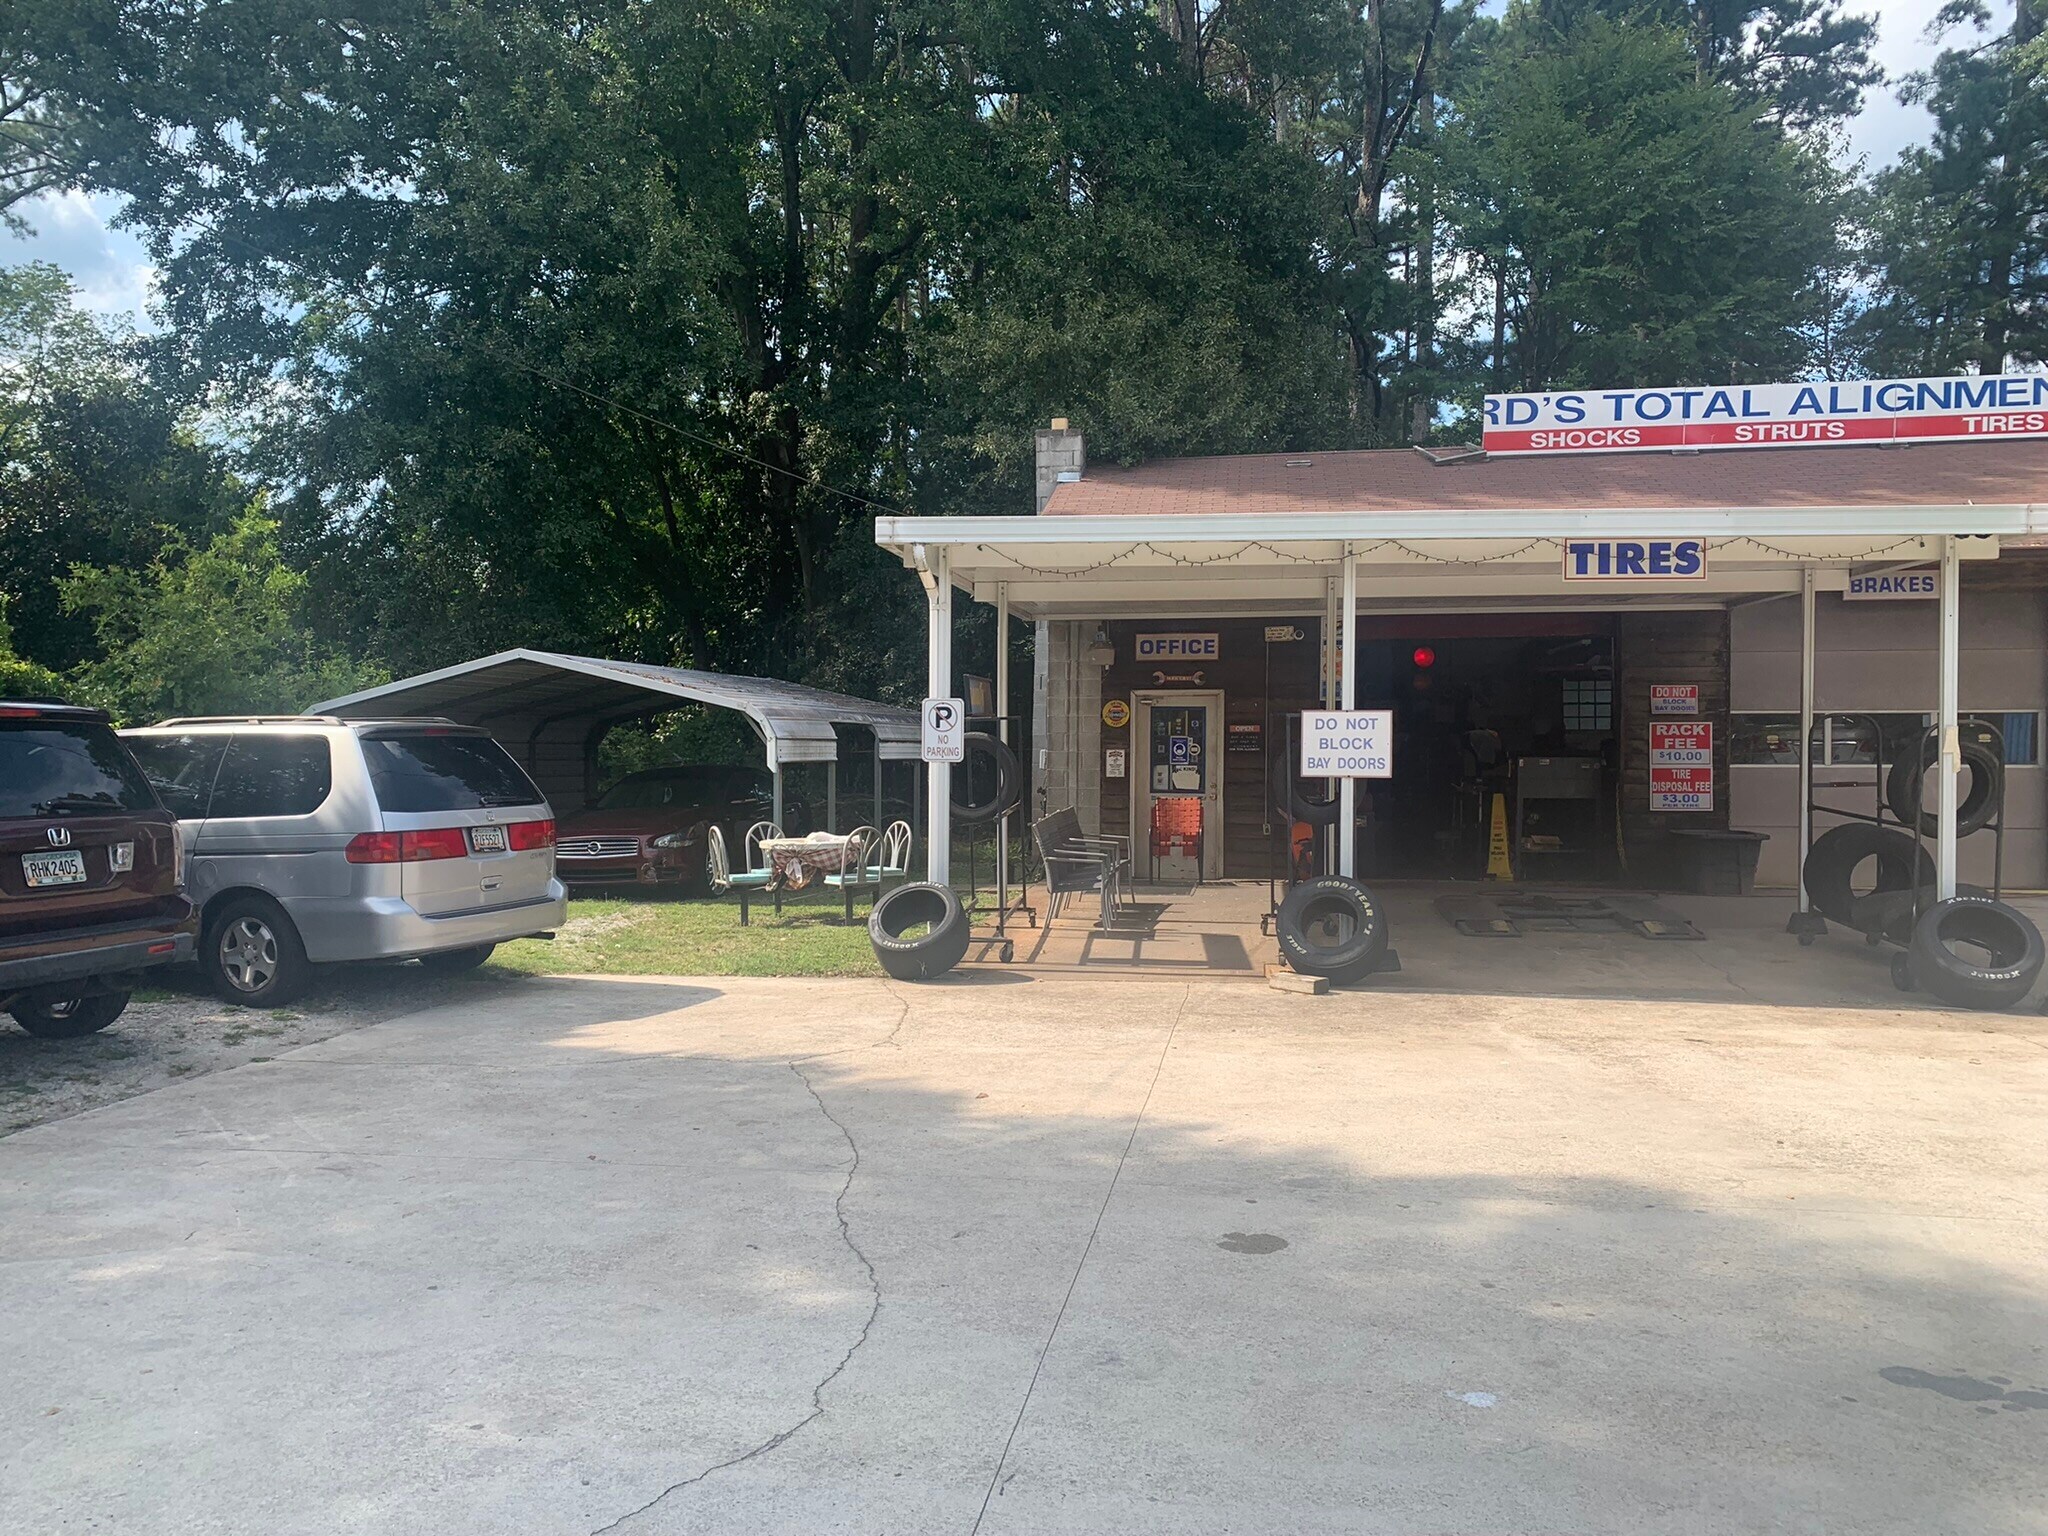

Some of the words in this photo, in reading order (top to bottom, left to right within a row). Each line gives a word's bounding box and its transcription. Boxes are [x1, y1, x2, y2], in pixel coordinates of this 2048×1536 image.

[1603, 390, 1771, 421] TOTAL
[1530, 429, 1641, 448] SHOCKS
[1735, 422, 1846, 441] STRUTS
[1962, 414, 2045, 433] TIRES
[1569, 541, 1701, 575] TIRES
[1850, 576, 1935, 594] BRAKES
[1140, 639, 1215, 655] OFFICE
[1656, 687, 1669, 697] DO
[1672, 687, 1692, 697] NOT
[1315, 718, 1338, 730] DO
[1346, 718, 1378, 730] NOT
[1656, 725, 1705, 735] RACK
[938, 735, 949, 744] NO
[1319, 738, 1374, 750] BLOCK
[1664, 738, 1697, 749] FEE
[926, 747, 960, 756] PARKING
[1659, 751, 1703, 761] $10.00
[1307, 757, 1331, 769] BAY
[1337, 757, 1386, 770] DOORS
[1672, 769, 1691, 779] TIRE
[1653, 781, 1693, 792] DISPOSAL
[1695, 781, 1711, 792] FEE
[1662, 794, 1699, 803] $3.00
[30, 860, 78, 878] RHK2405
[1317, 881, 1373, 917] GOODYEAR
